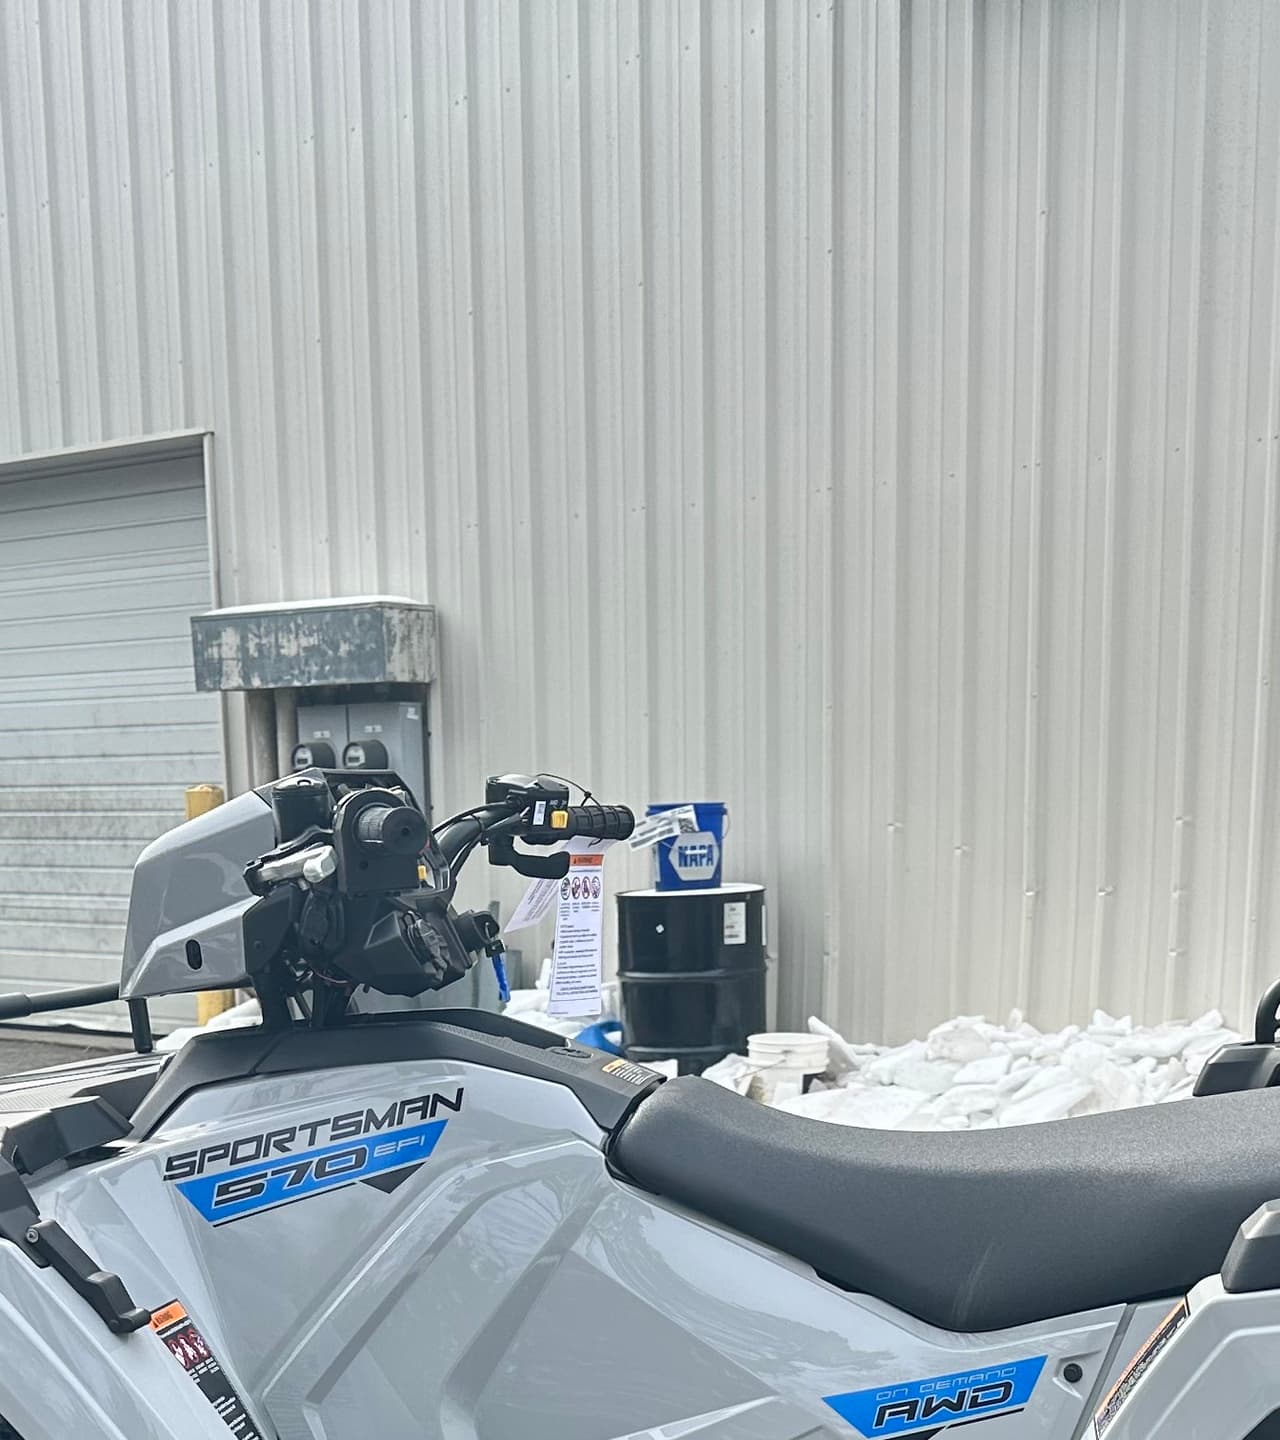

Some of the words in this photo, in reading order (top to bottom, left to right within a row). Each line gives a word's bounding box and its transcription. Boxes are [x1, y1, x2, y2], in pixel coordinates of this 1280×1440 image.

[678, 844, 713, 867] NAPA
[163, 1087, 465, 1181] SPORTSMAN
[211, 1144, 369, 1209] 570
[373, 1135, 425, 1158] EFI
[872, 1380, 1015, 1429] AWD
[875, 1387, 908, 1401] ON
[919, 1366, 1017, 1393] DEMAND
